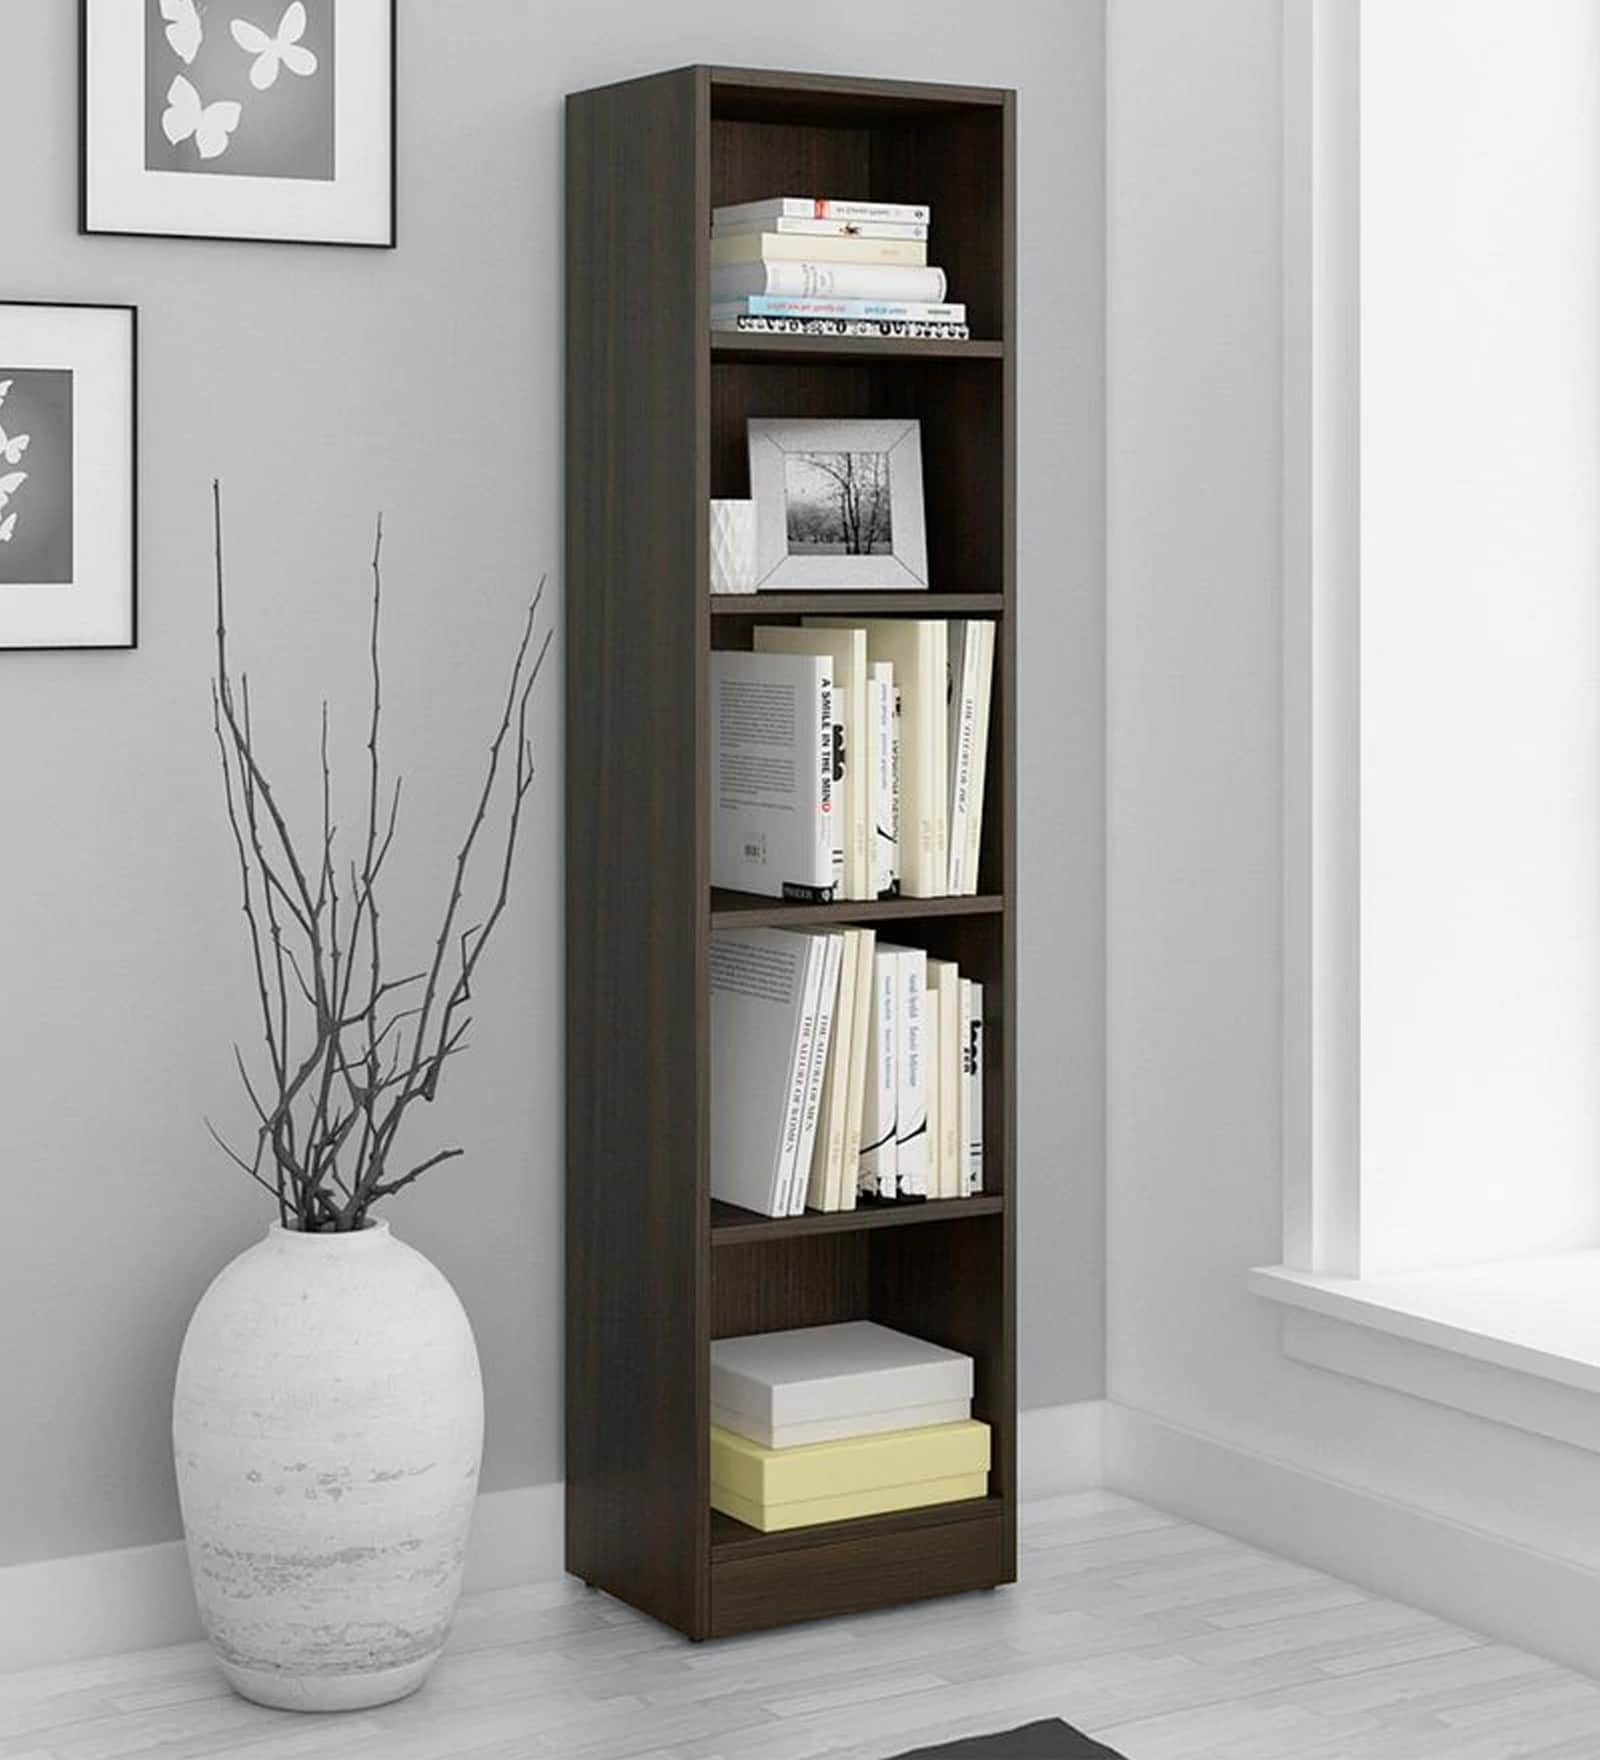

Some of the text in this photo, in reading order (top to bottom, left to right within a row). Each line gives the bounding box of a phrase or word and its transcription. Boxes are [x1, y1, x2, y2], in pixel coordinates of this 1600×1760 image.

[821, 678, 832, 813] A SMILE IN THE MIND
[784, 1015, 812, 1153] THE ALLURE OF WOMEN
[804, 1013, 829, 1132] THE ALLURE OF MEN
